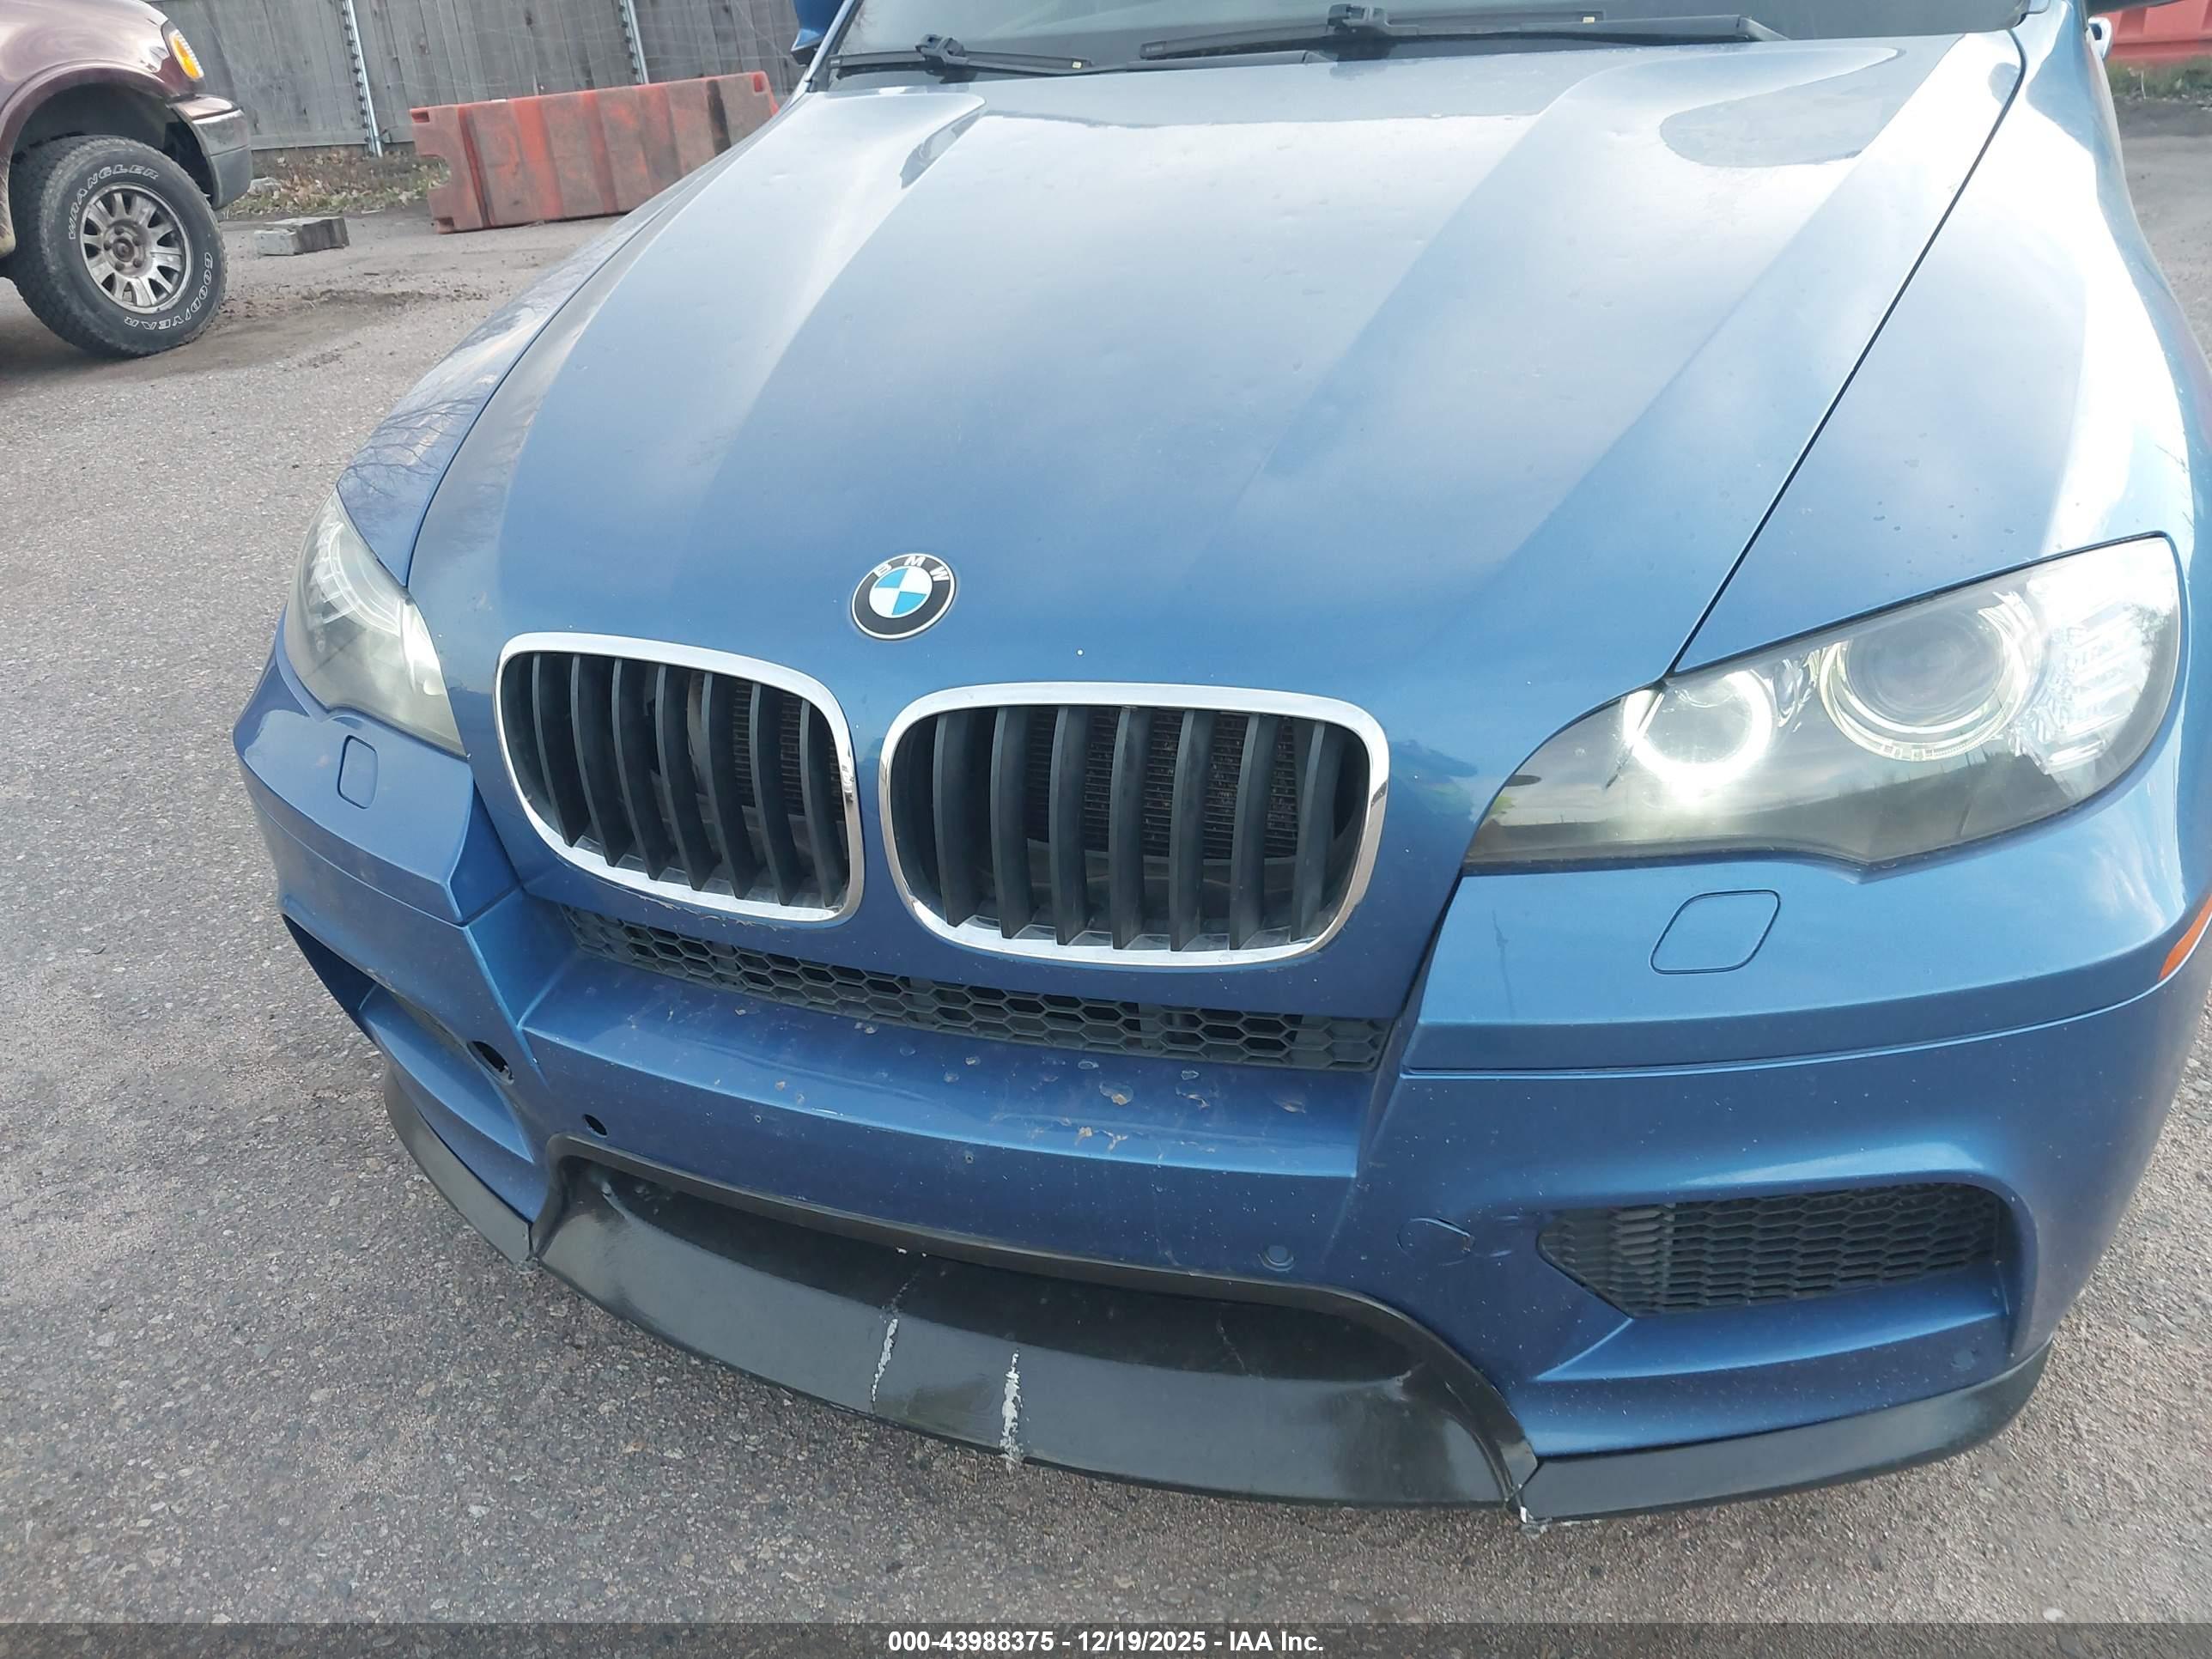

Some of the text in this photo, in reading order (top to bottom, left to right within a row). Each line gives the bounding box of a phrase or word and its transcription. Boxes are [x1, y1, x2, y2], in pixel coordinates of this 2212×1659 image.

[69, 164, 159, 240] WRANGLER
[124, 252, 214, 331] GOODYEAR
[872, 555, 951, 582] BMW
